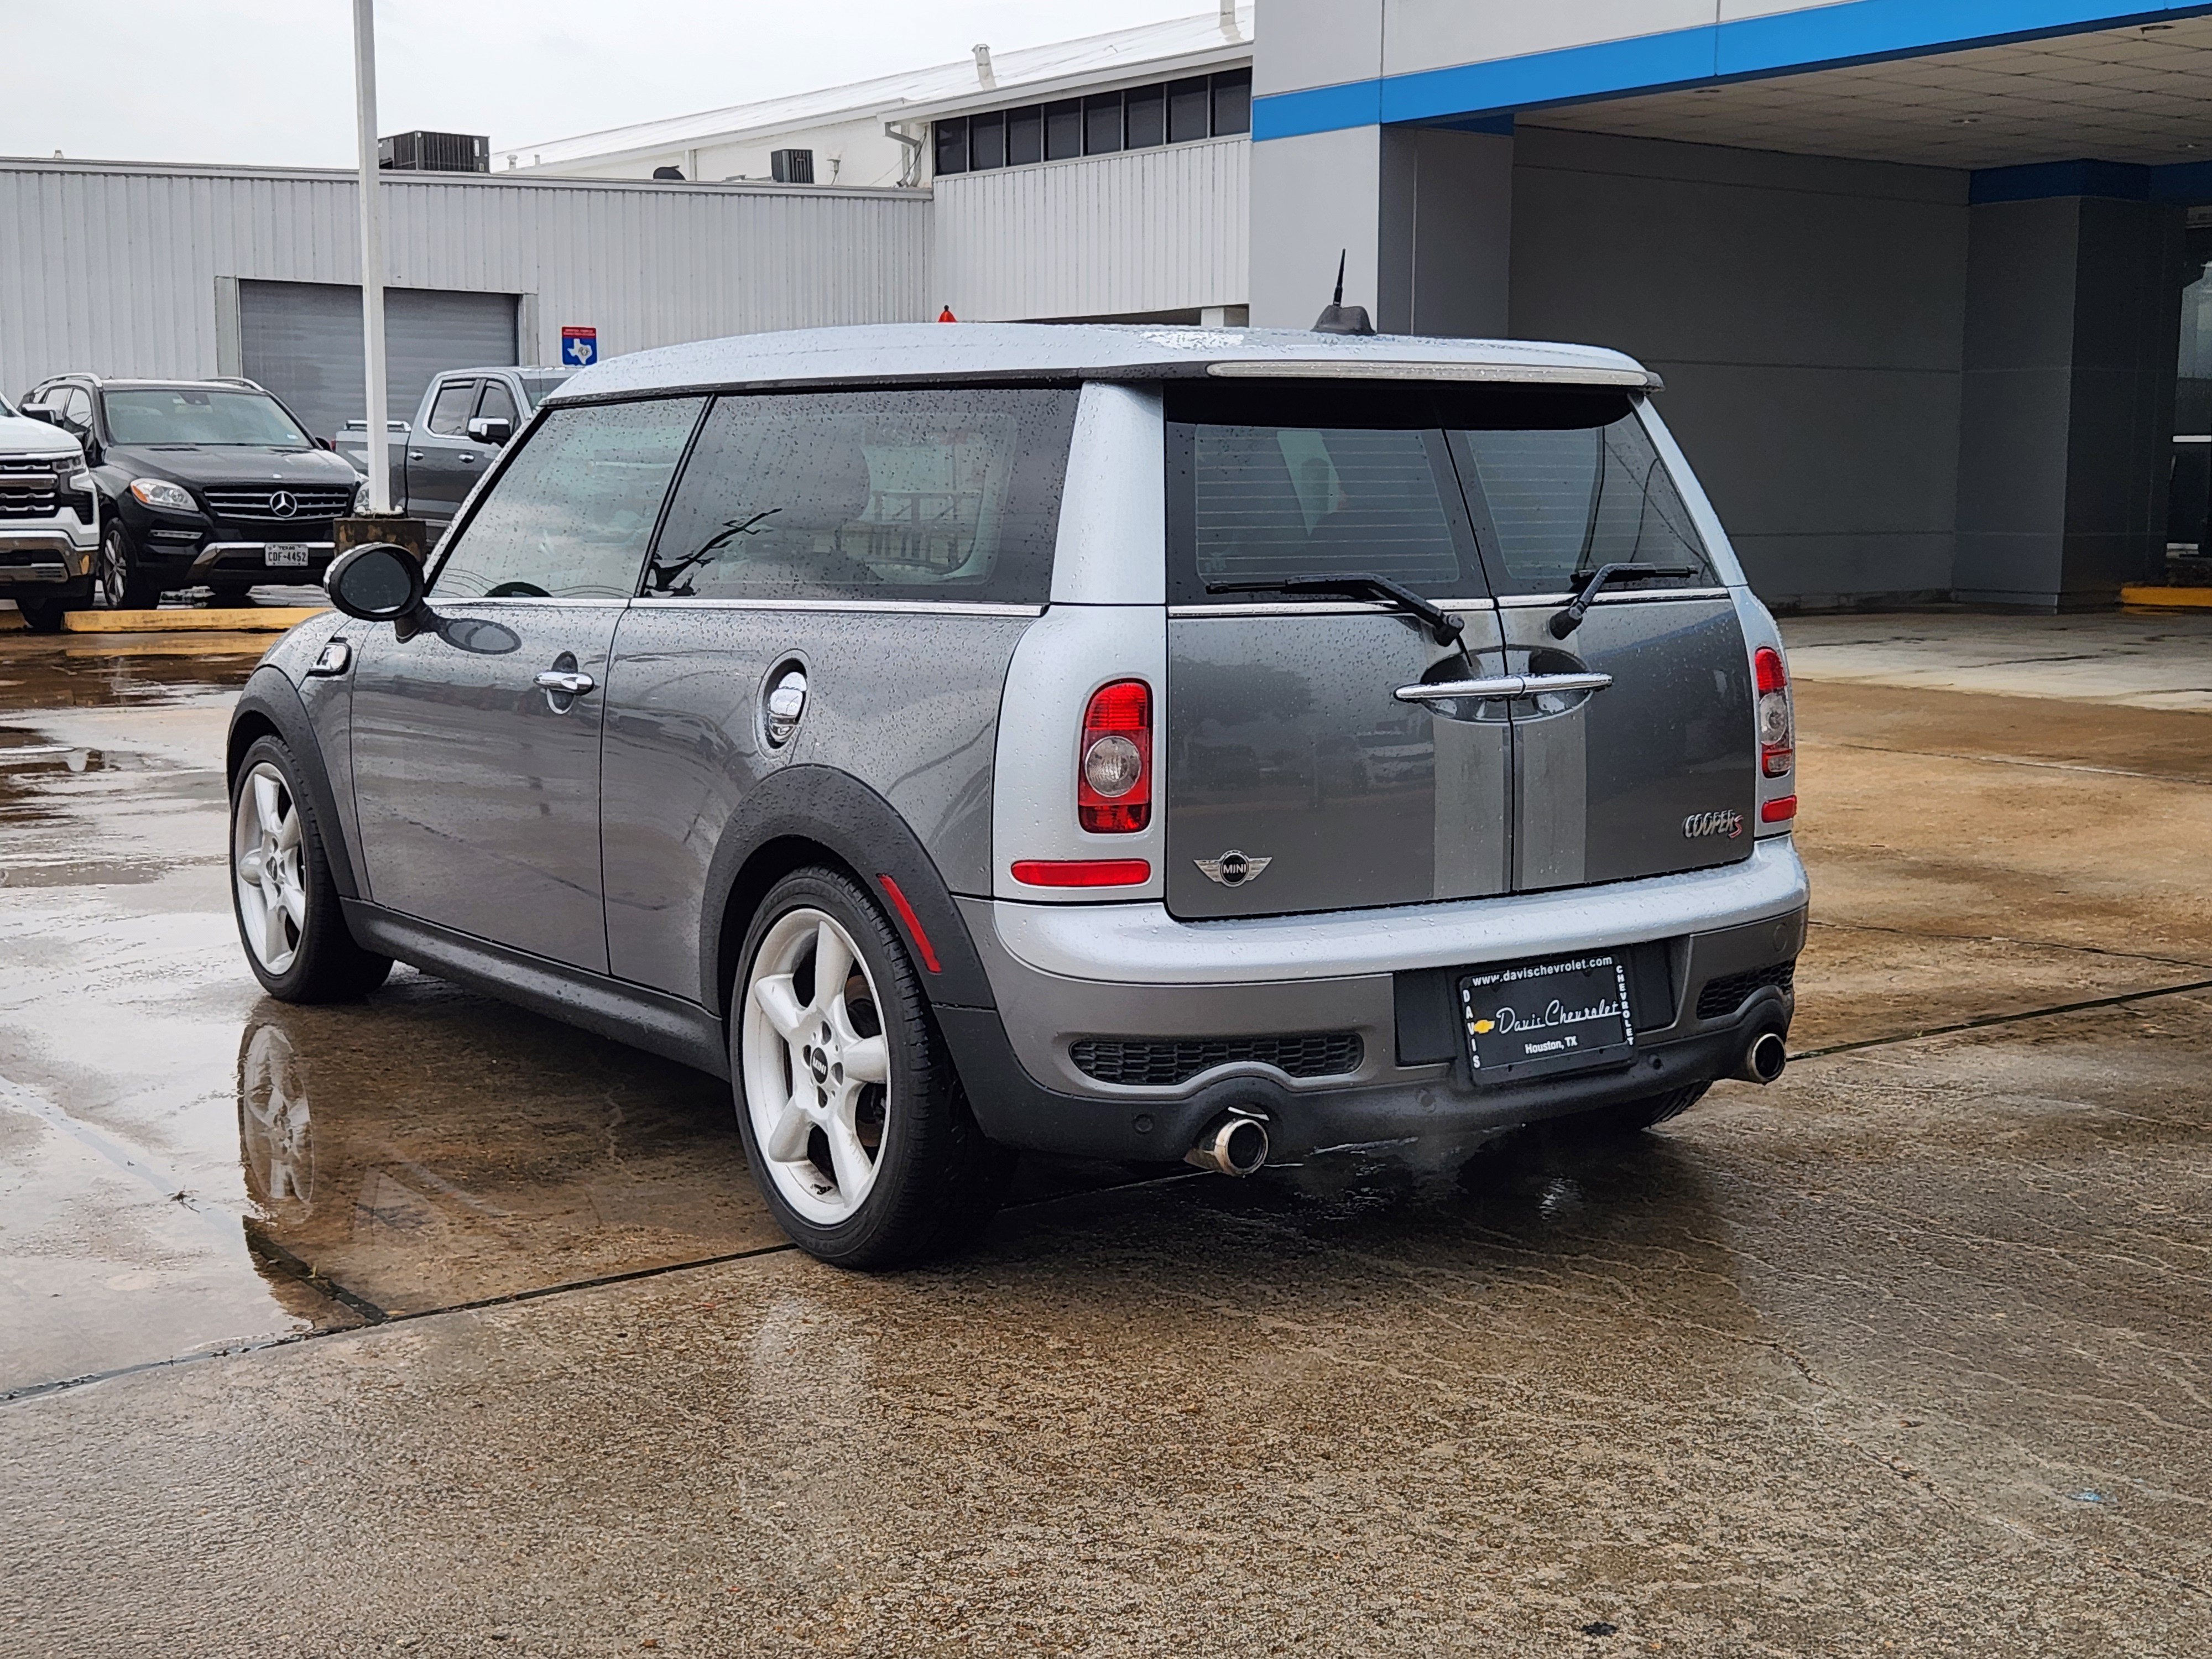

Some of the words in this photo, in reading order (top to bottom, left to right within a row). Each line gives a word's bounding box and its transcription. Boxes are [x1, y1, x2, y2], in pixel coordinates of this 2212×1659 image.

[1728, 815, 1744, 839] S
[1223, 863, 1246, 874] MINI
[1473, 956, 1613, 986] www.davischevrolet.com
[1496, 1007, 1546, 1034] Davis
[1545, 999, 1621, 1026] Chevrolet
[1616, 965, 1634, 1046] CHEVROLET
[1463, 989, 1481, 1068] DAVIS
[1525, 1041, 1564, 1055] Houston,
[1564, 1036, 1578, 1047] TX
